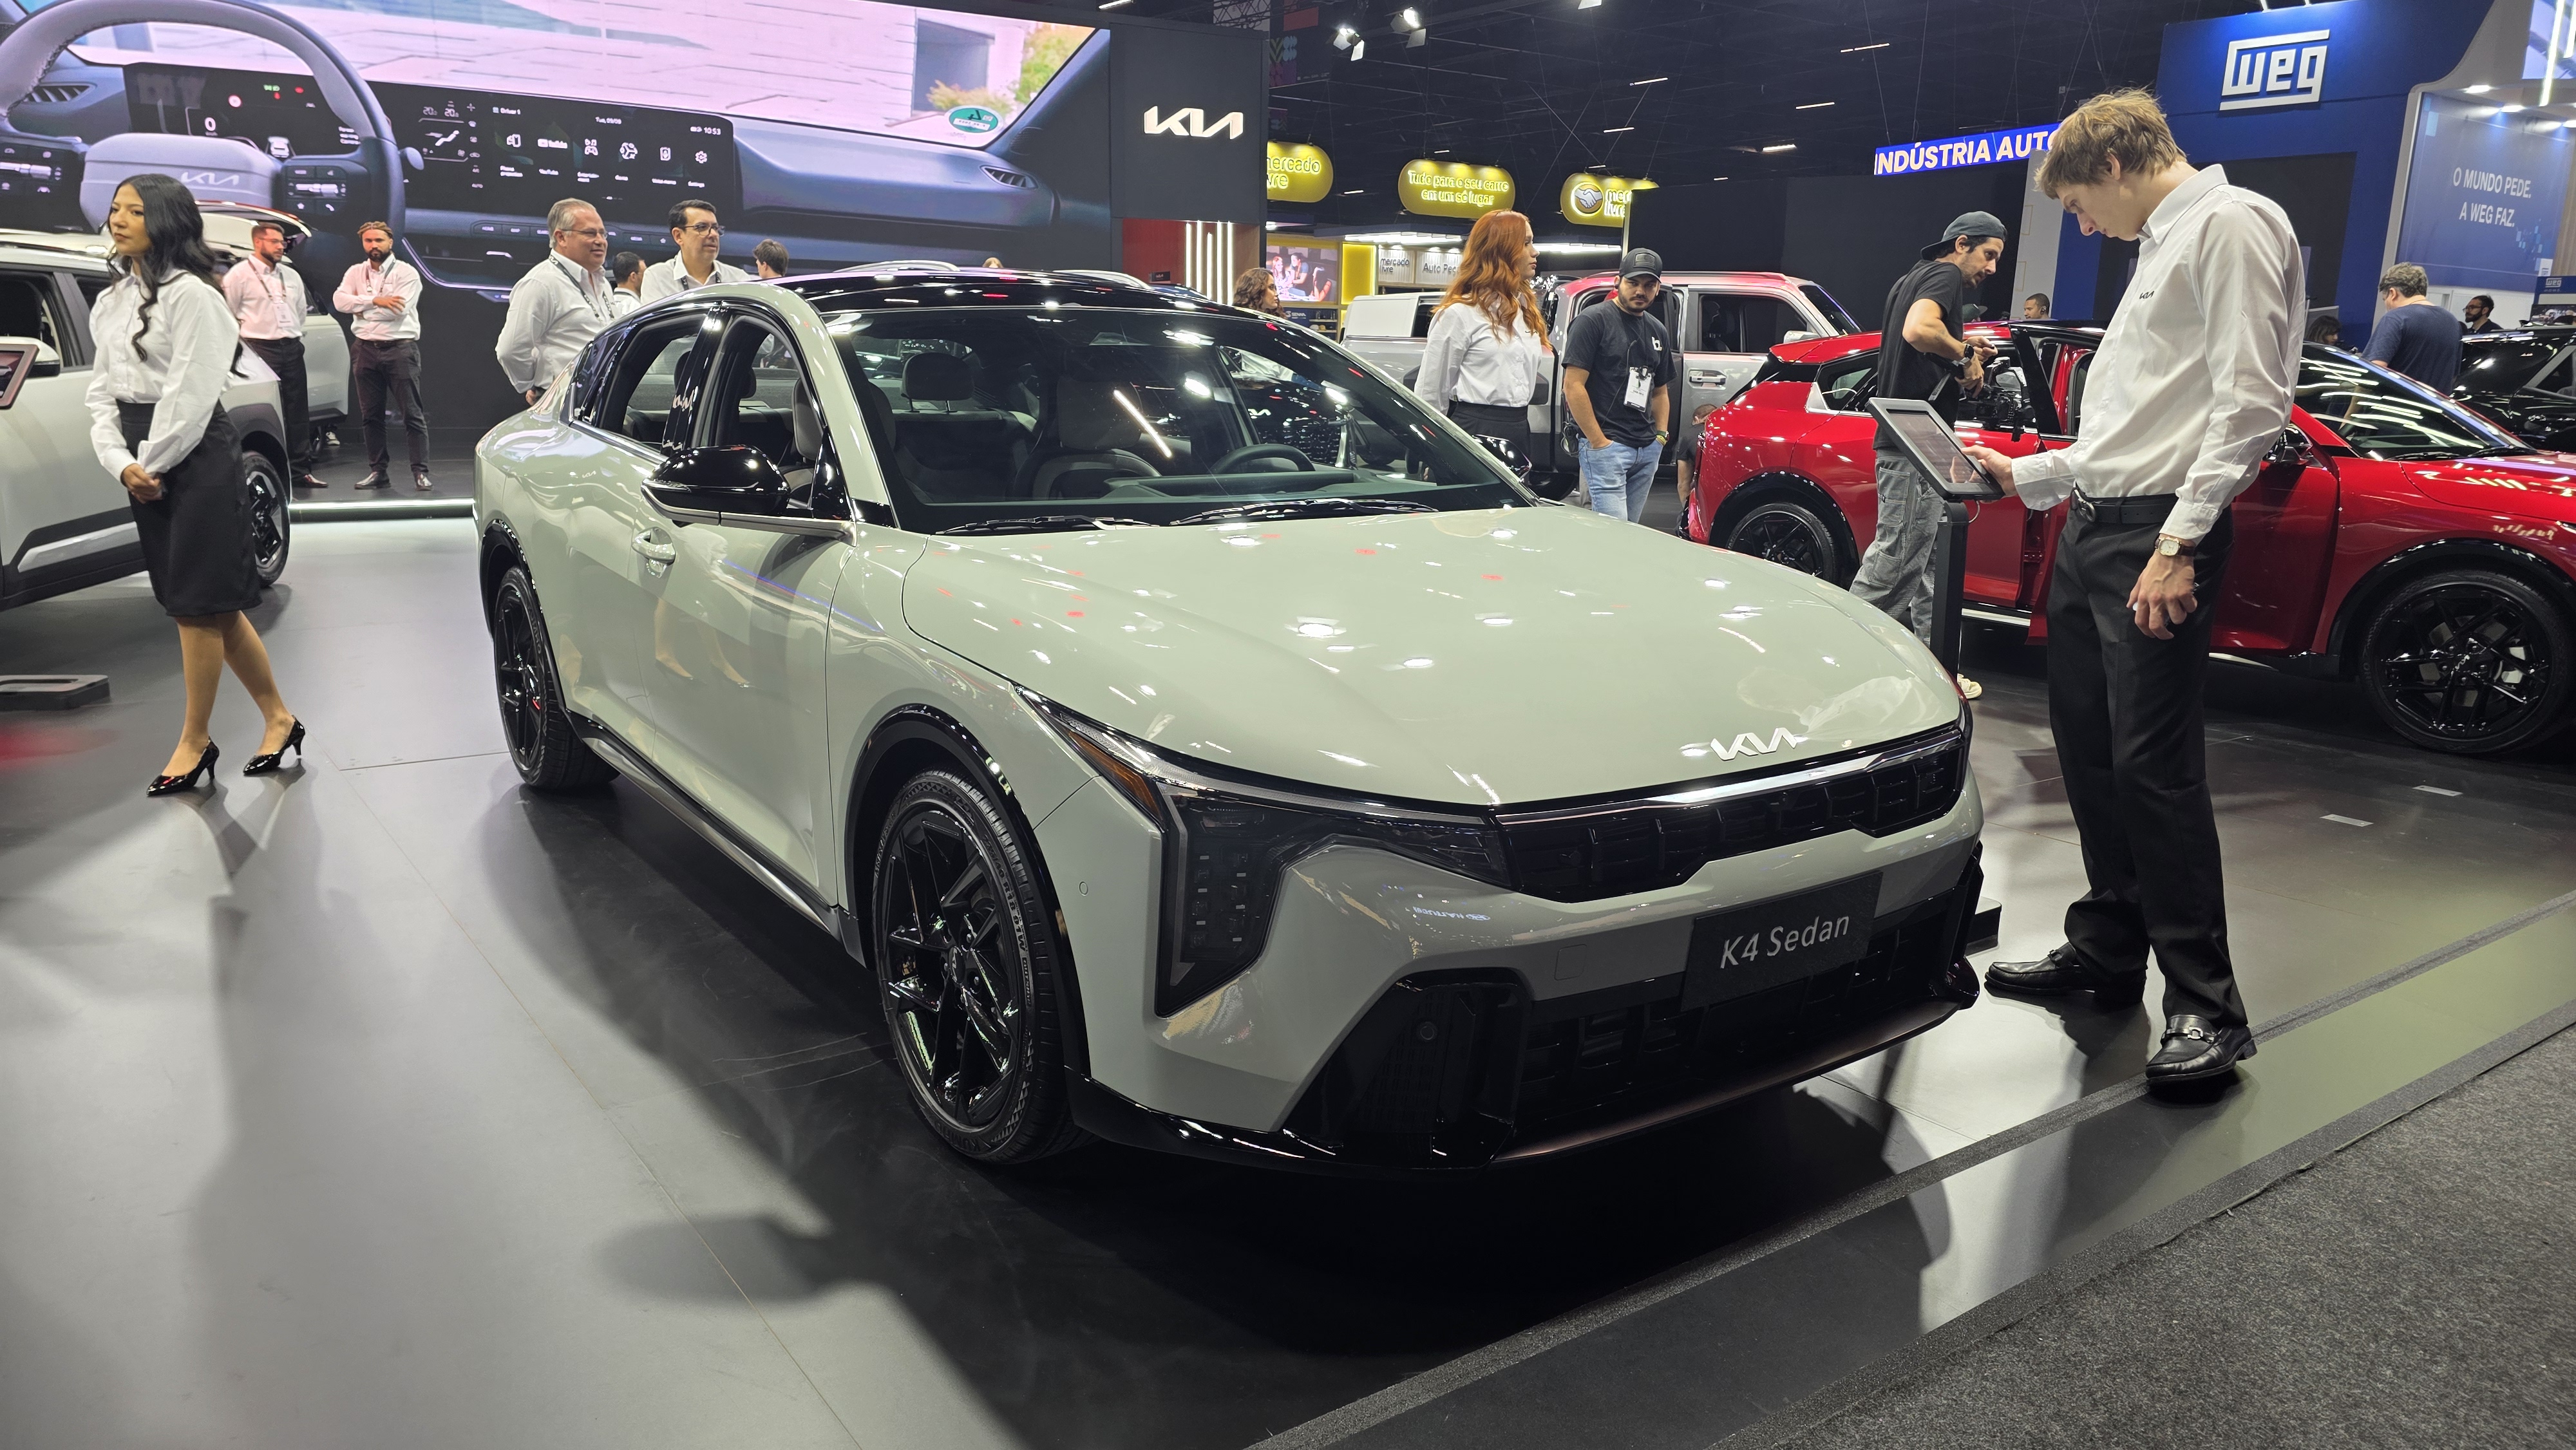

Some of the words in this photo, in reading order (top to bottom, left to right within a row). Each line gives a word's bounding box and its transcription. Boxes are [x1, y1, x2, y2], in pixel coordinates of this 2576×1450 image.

[1144, 106, 1243, 140] KIA
[1874, 139, 1991, 175] INDÚSTRIA
[1408, 171, 1432, 185] Tudo
[1434, 176, 1455, 189] para
[1456, 180, 1463, 188] o
[1464, 179, 1482, 190] seu
[1484, 181, 1510, 192] carro
[2453, 167, 2461, 186] O
[2463, 169, 2503, 193] MUNDO
[2504, 176, 2531, 198] PEDE.
[1421, 189, 1437, 201] em
[1439, 191, 1454, 202] um
[1469, 191, 1494, 207] lugar
[2459, 202, 2467, 220] A
[2470, 203, 2494, 224] WEG
[2494, 207, 2515, 227] FAZ.
[1381, 258, 1410, 266] mercado
[1423, 263, 1441, 274] Auto
[2139, 290, 2155, 299] KIA
[1710, 727, 1799, 761] KIA
[1720, 933, 1760, 969] K4
[1767, 916, 1850, 957] Sedan
